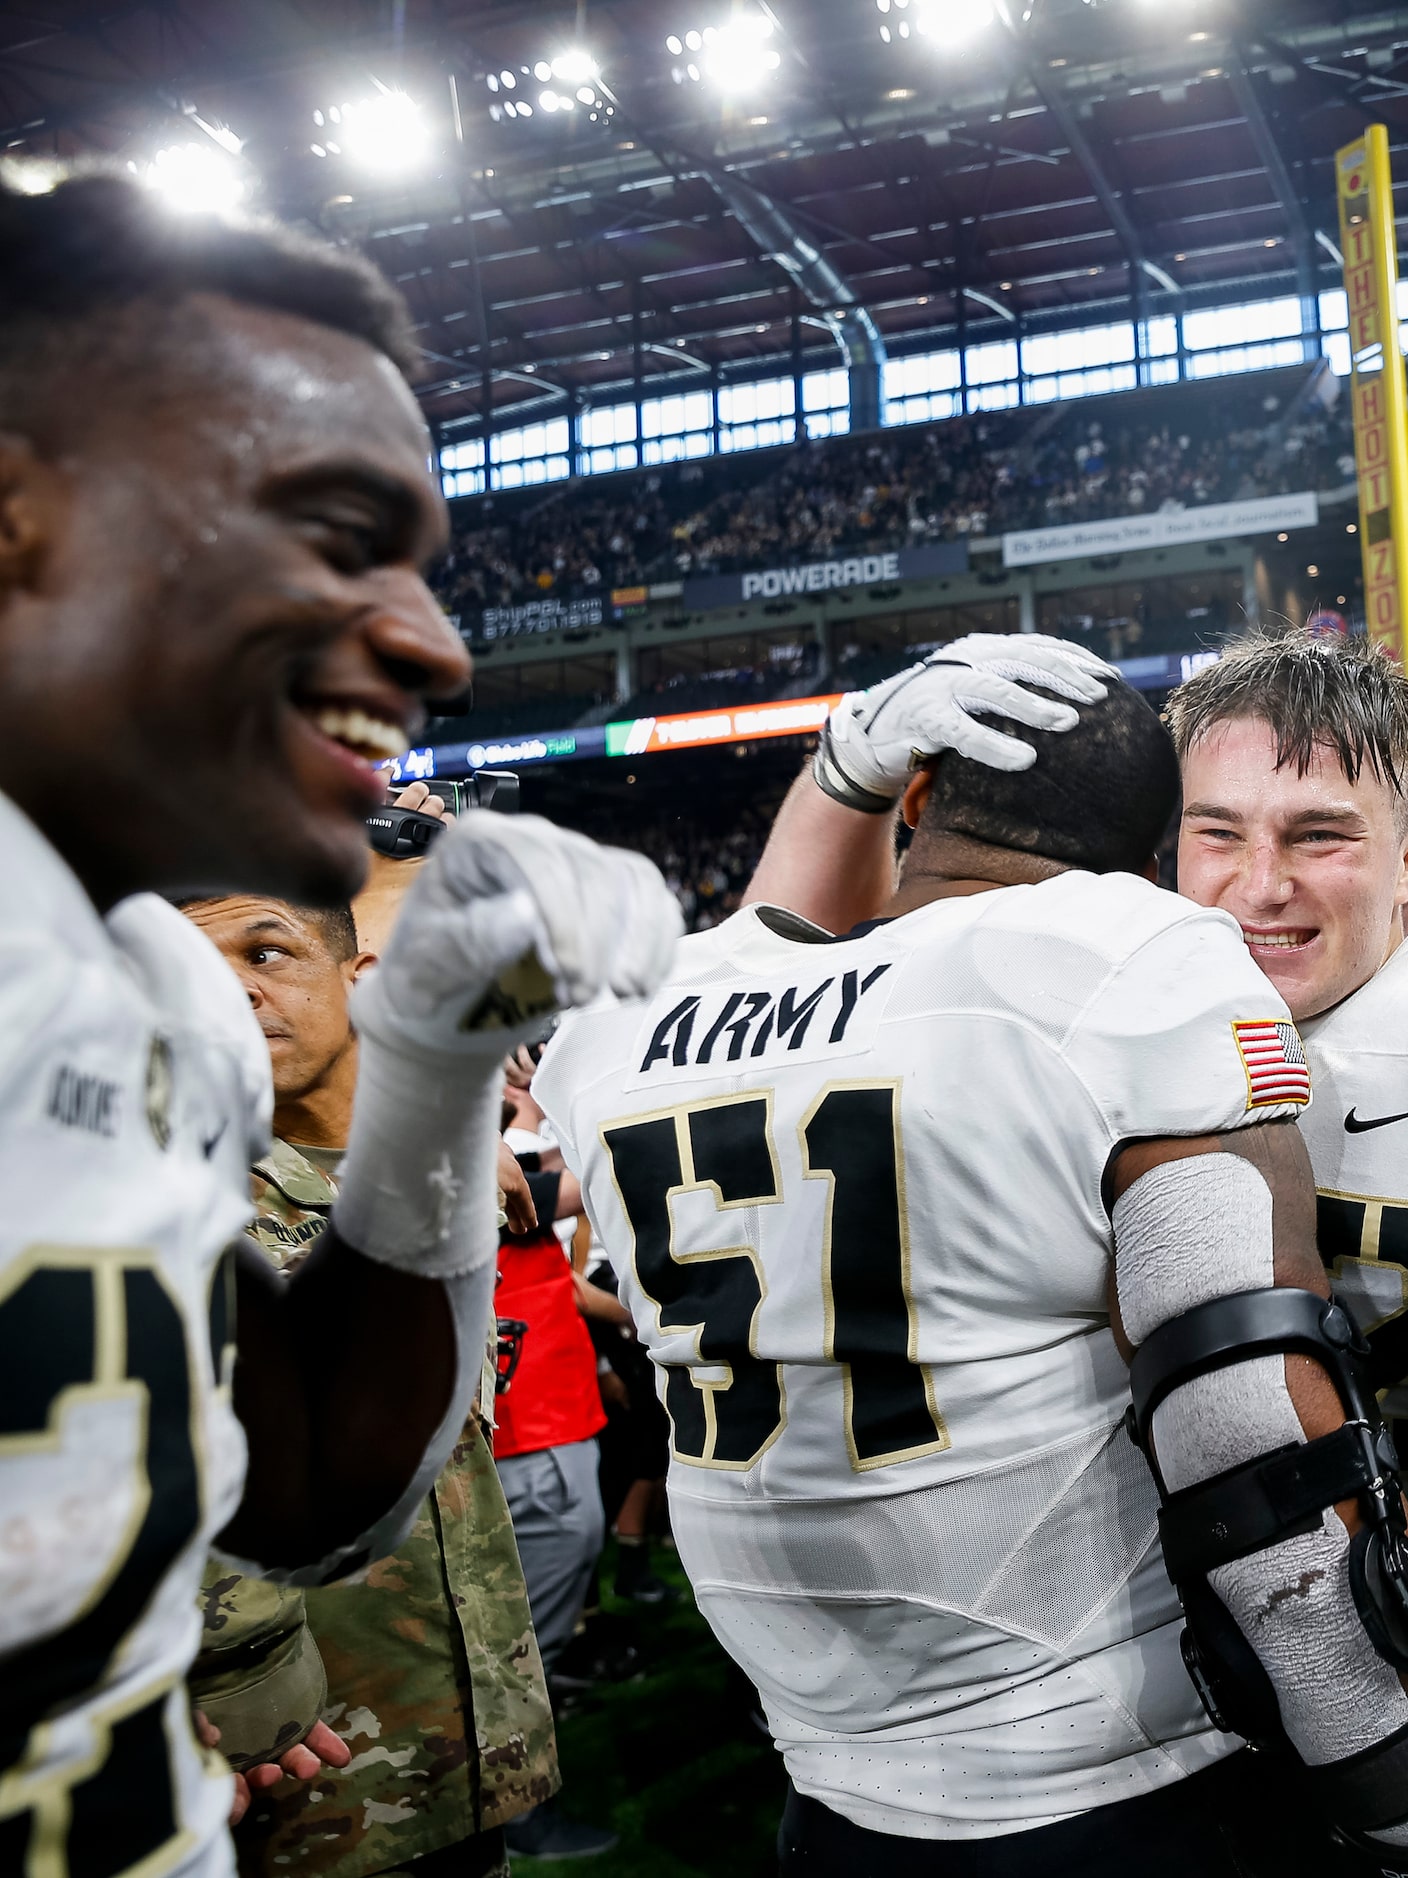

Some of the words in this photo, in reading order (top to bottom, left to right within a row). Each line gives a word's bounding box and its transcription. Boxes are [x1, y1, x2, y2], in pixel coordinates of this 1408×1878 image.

[742, 552, 900, 600] POWERADE
[638, 963, 893, 1073] ARMY
[598, 1076, 952, 1472] 51
